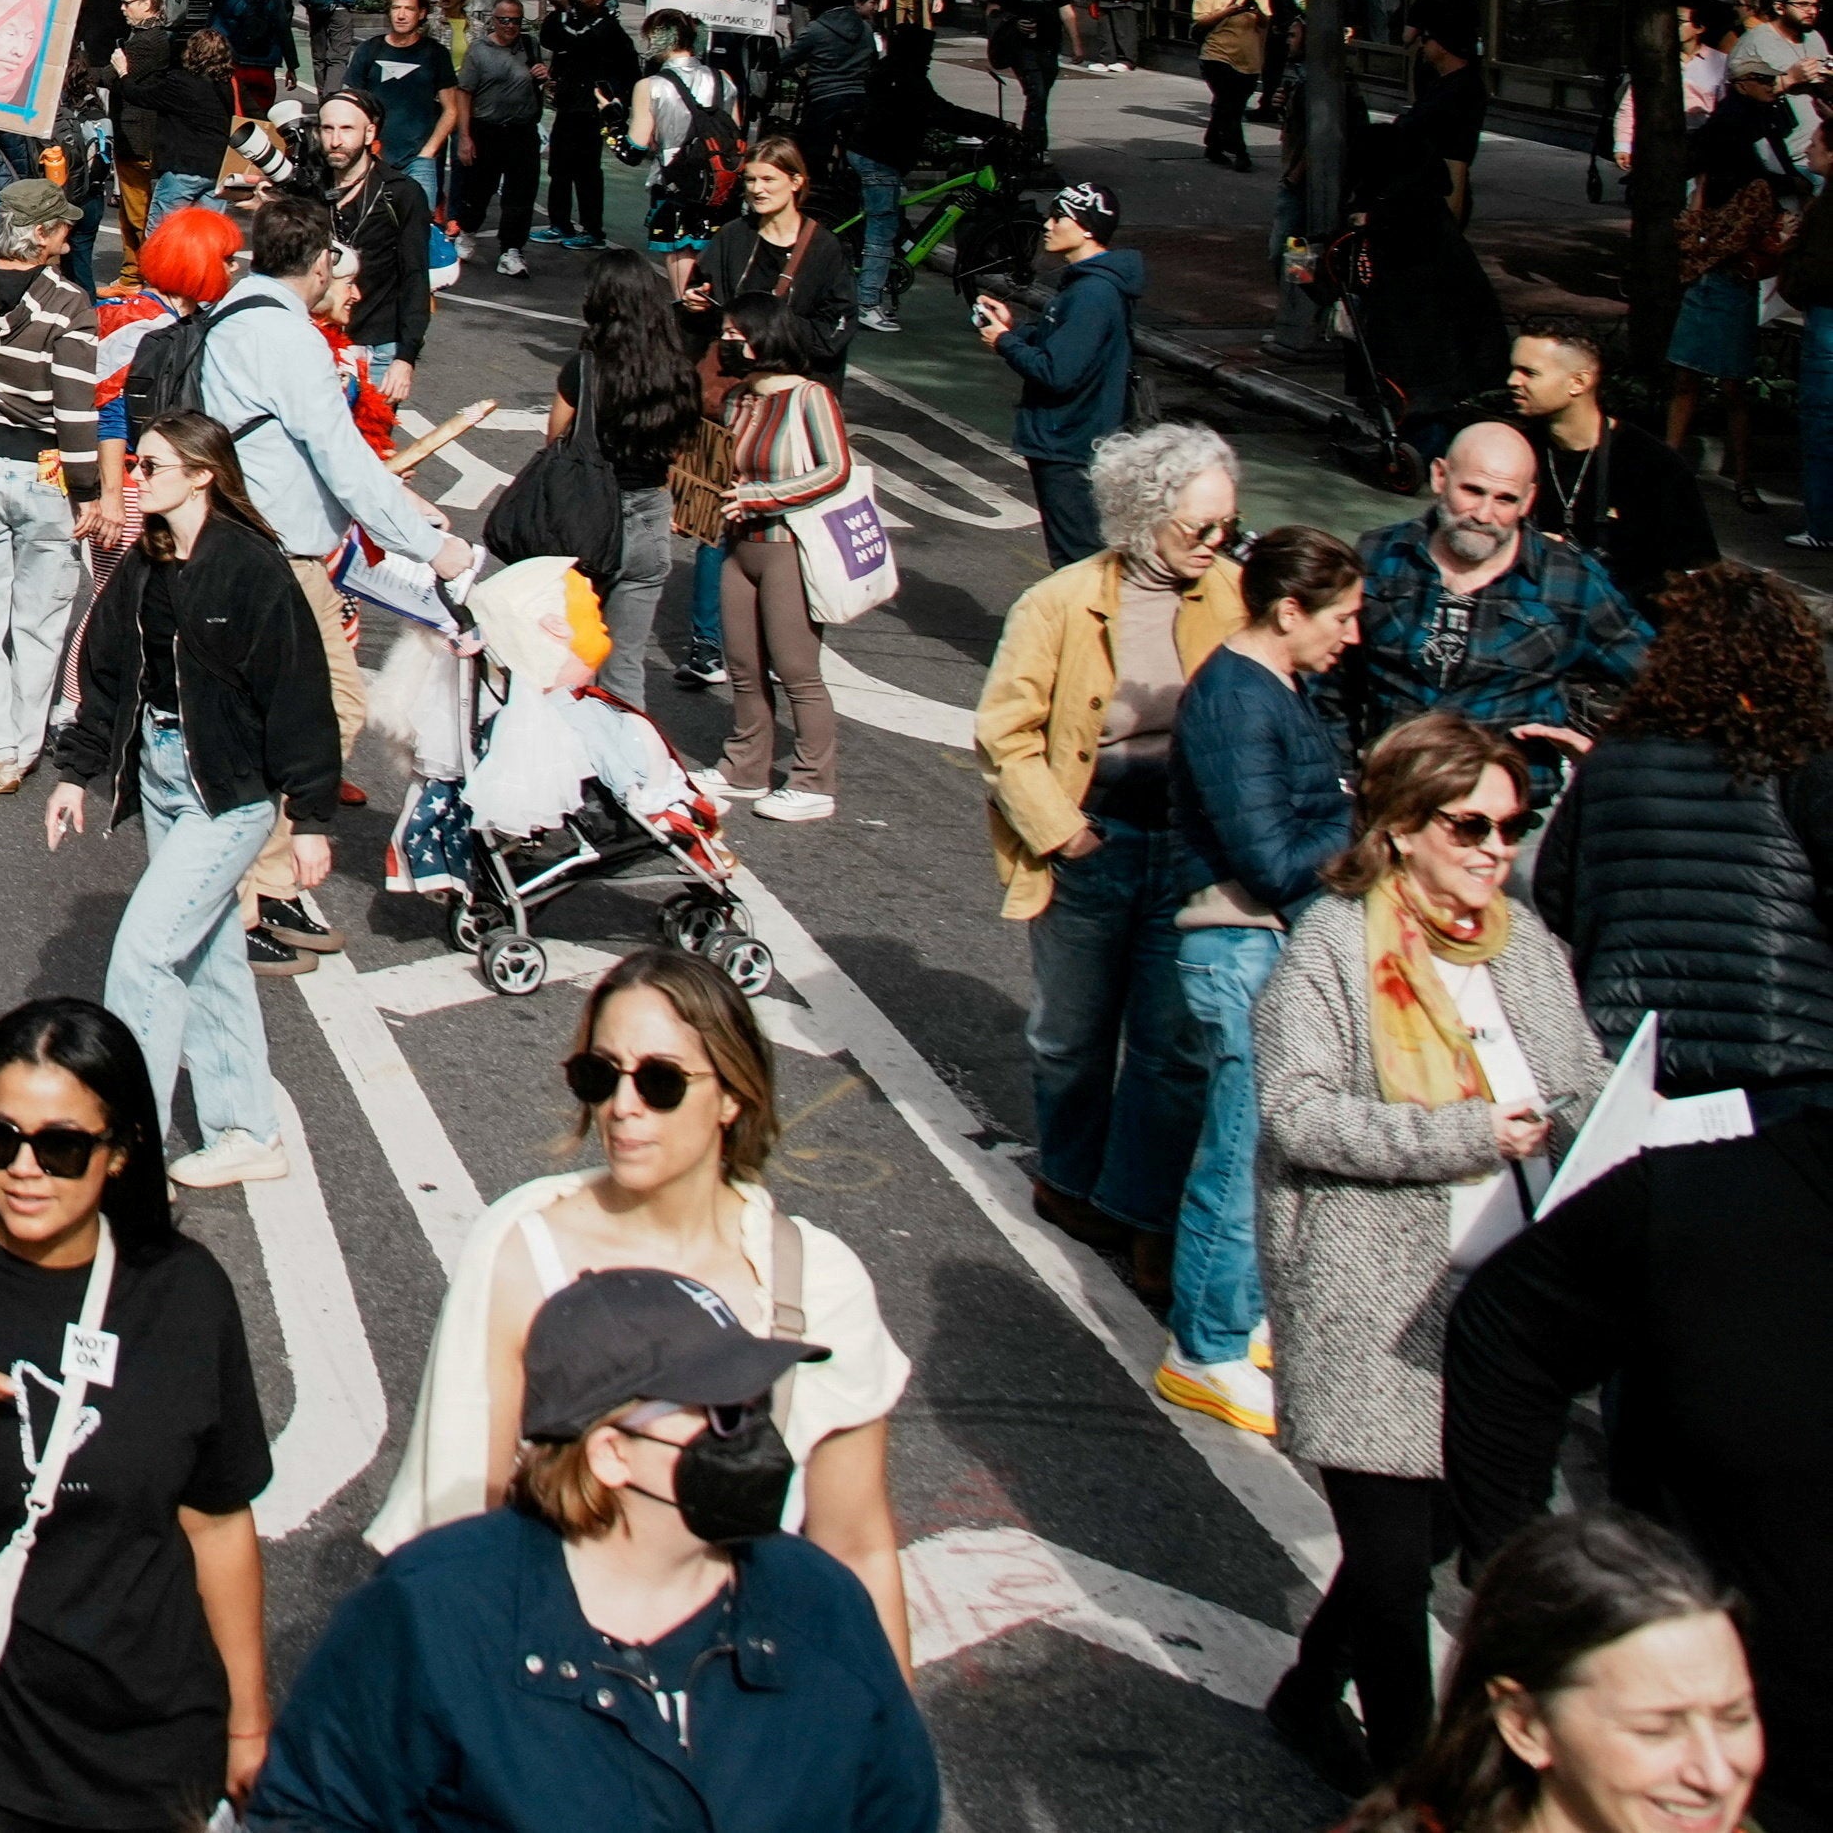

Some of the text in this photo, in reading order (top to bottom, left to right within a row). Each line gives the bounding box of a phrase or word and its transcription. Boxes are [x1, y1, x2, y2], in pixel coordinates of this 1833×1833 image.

[702, 12, 769, 27] THAT MAKE YOU
[844, 509, 871, 531] WE
[851, 524, 880, 549] ARE
[854, 542, 885, 565] NYU
[74, 1333, 109, 1353] NOT
[76, 1352, 100, 1369] OK
